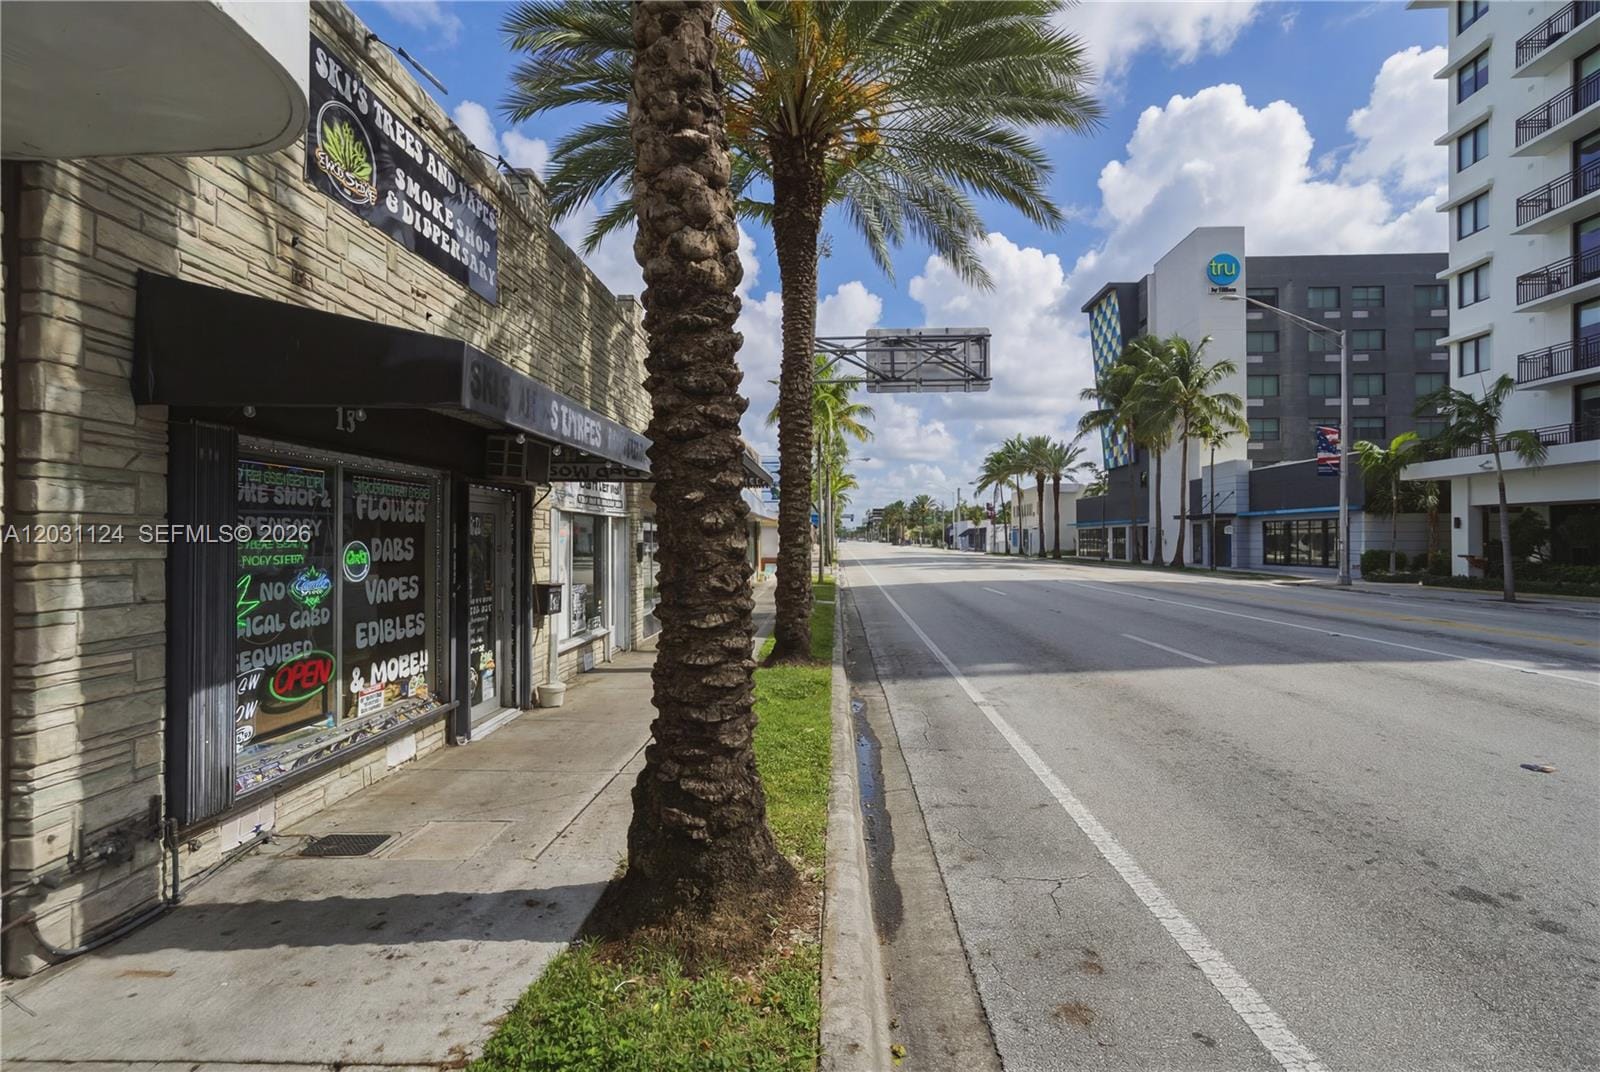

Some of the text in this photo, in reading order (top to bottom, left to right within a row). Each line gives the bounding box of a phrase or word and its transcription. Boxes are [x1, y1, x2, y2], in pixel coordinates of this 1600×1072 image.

[315, 47, 369, 115] SKI'S
[373, 99, 424, 165] TREES
[426, 152, 457, 194] AND
[458, 181, 497, 231] VAPES
[385, 189, 399, 214] &
[394, 167, 454, 230] SMOKE
[455, 218, 491, 259] SHOP
[1210, 260, 1236, 275] tru
[356, 494, 426, 523] FLOWER
[371, 537, 415, 562] DABS
[259, 582, 286, 601] NO
[365, 575, 420, 605] VAPES
[355, 612, 426, 650] EDIBLES
[273, 658, 332, 695] OPEN
[350, 666, 365, 694] &
